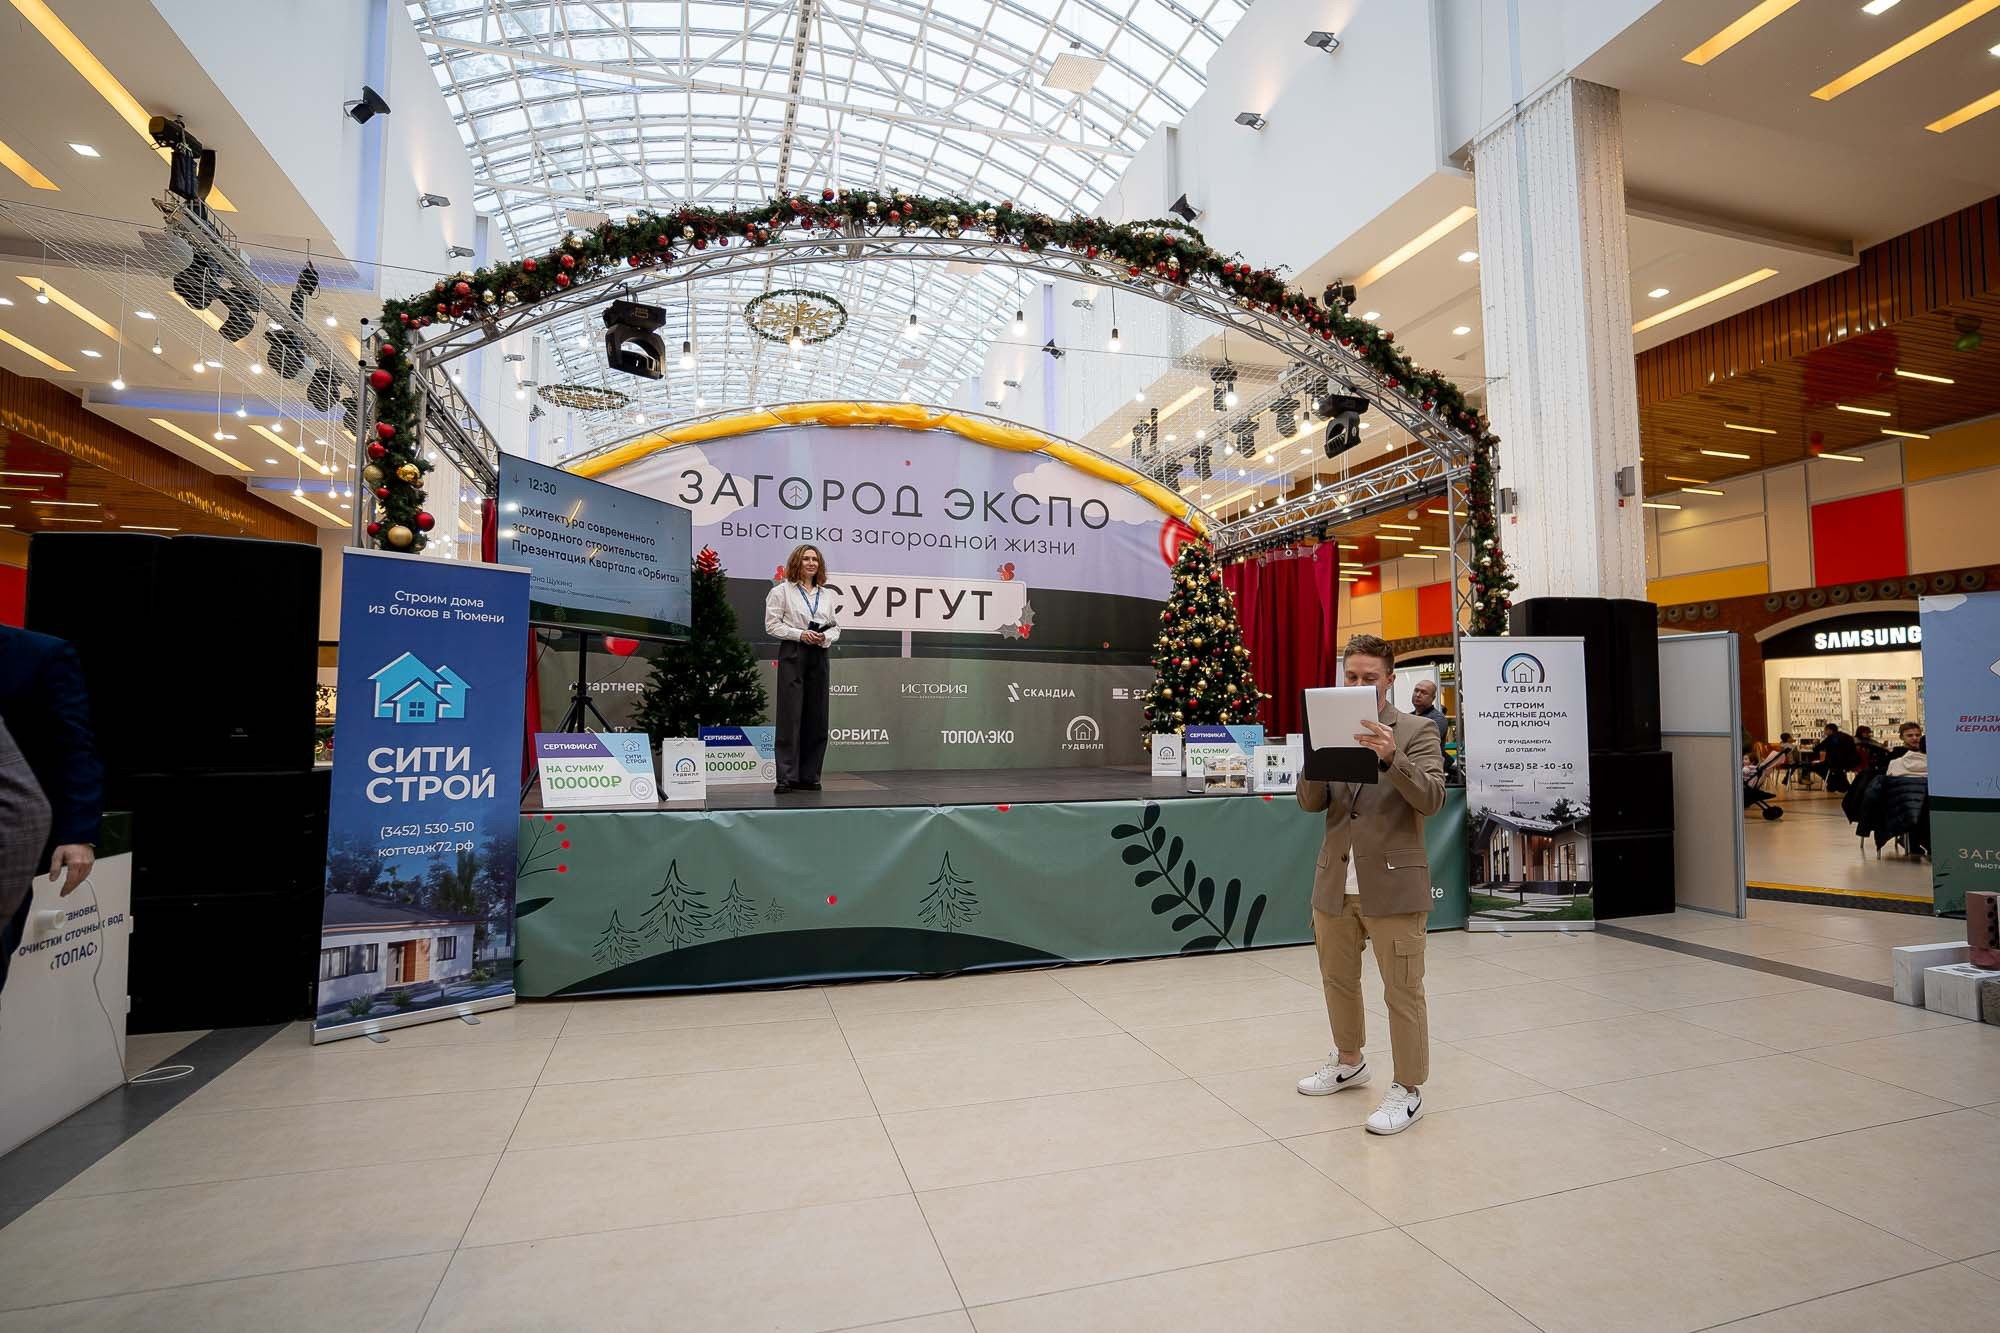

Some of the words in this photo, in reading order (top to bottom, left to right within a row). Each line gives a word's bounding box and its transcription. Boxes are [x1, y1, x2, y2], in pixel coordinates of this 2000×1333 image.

[528, 477, 557, 495] 12:30
[678, 469, 923, 518] ЗАГОРОД
[944, 488, 1110, 529] ЭКСПО
[518, 505, 585, 529] рхитектура
[587, 522, 656, 546] современного
[721, 521, 843, 542] выставка
[851, 528, 997, 551] загородной
[1004, 537, 1075, 555] жизни
[585, 540, 658, 563] строительства.
[512, 539, 586, 565] Презентация
[589, 555, 636, 575] Квартала
[637, 567, 680, 583] «Орбита»
[394, 590, 447, 605] Строим
[450, 597, 484, 608] дома
[368, 604, 386, 614] из
[389, 604, 439, 618] блоков
[442, 610, 450, 619] в
[454, 609, 505, 624] Тюмени
[1814, 625, 1922, 649] SAMSUNG
[901, 683, 968, 694] ИСТОРИЯ
[1023, 688, 1076, 698] СКАНДИА
[1496, 686, 1552, 694] ГУДВИЛЛ
[1497, 720, 1519, 728] ПОД
[1955, 724, 2000, 732] КЕРАМ
[830, 729, 889, 741] ОРБИТА
[367, 746, 471, 774] СИТИ
[546, 765, 563, 773] НА
[565, 764, 604, 773] СУММУ
[366, 767, 496, 804] СТРОЙ
[380, 823, 420, 839] (3452)
[424, 821, 475, 834] 530-510
[378, 840, 474, 857] коттедж72.рф
[107, 913, 124, 927] вод
